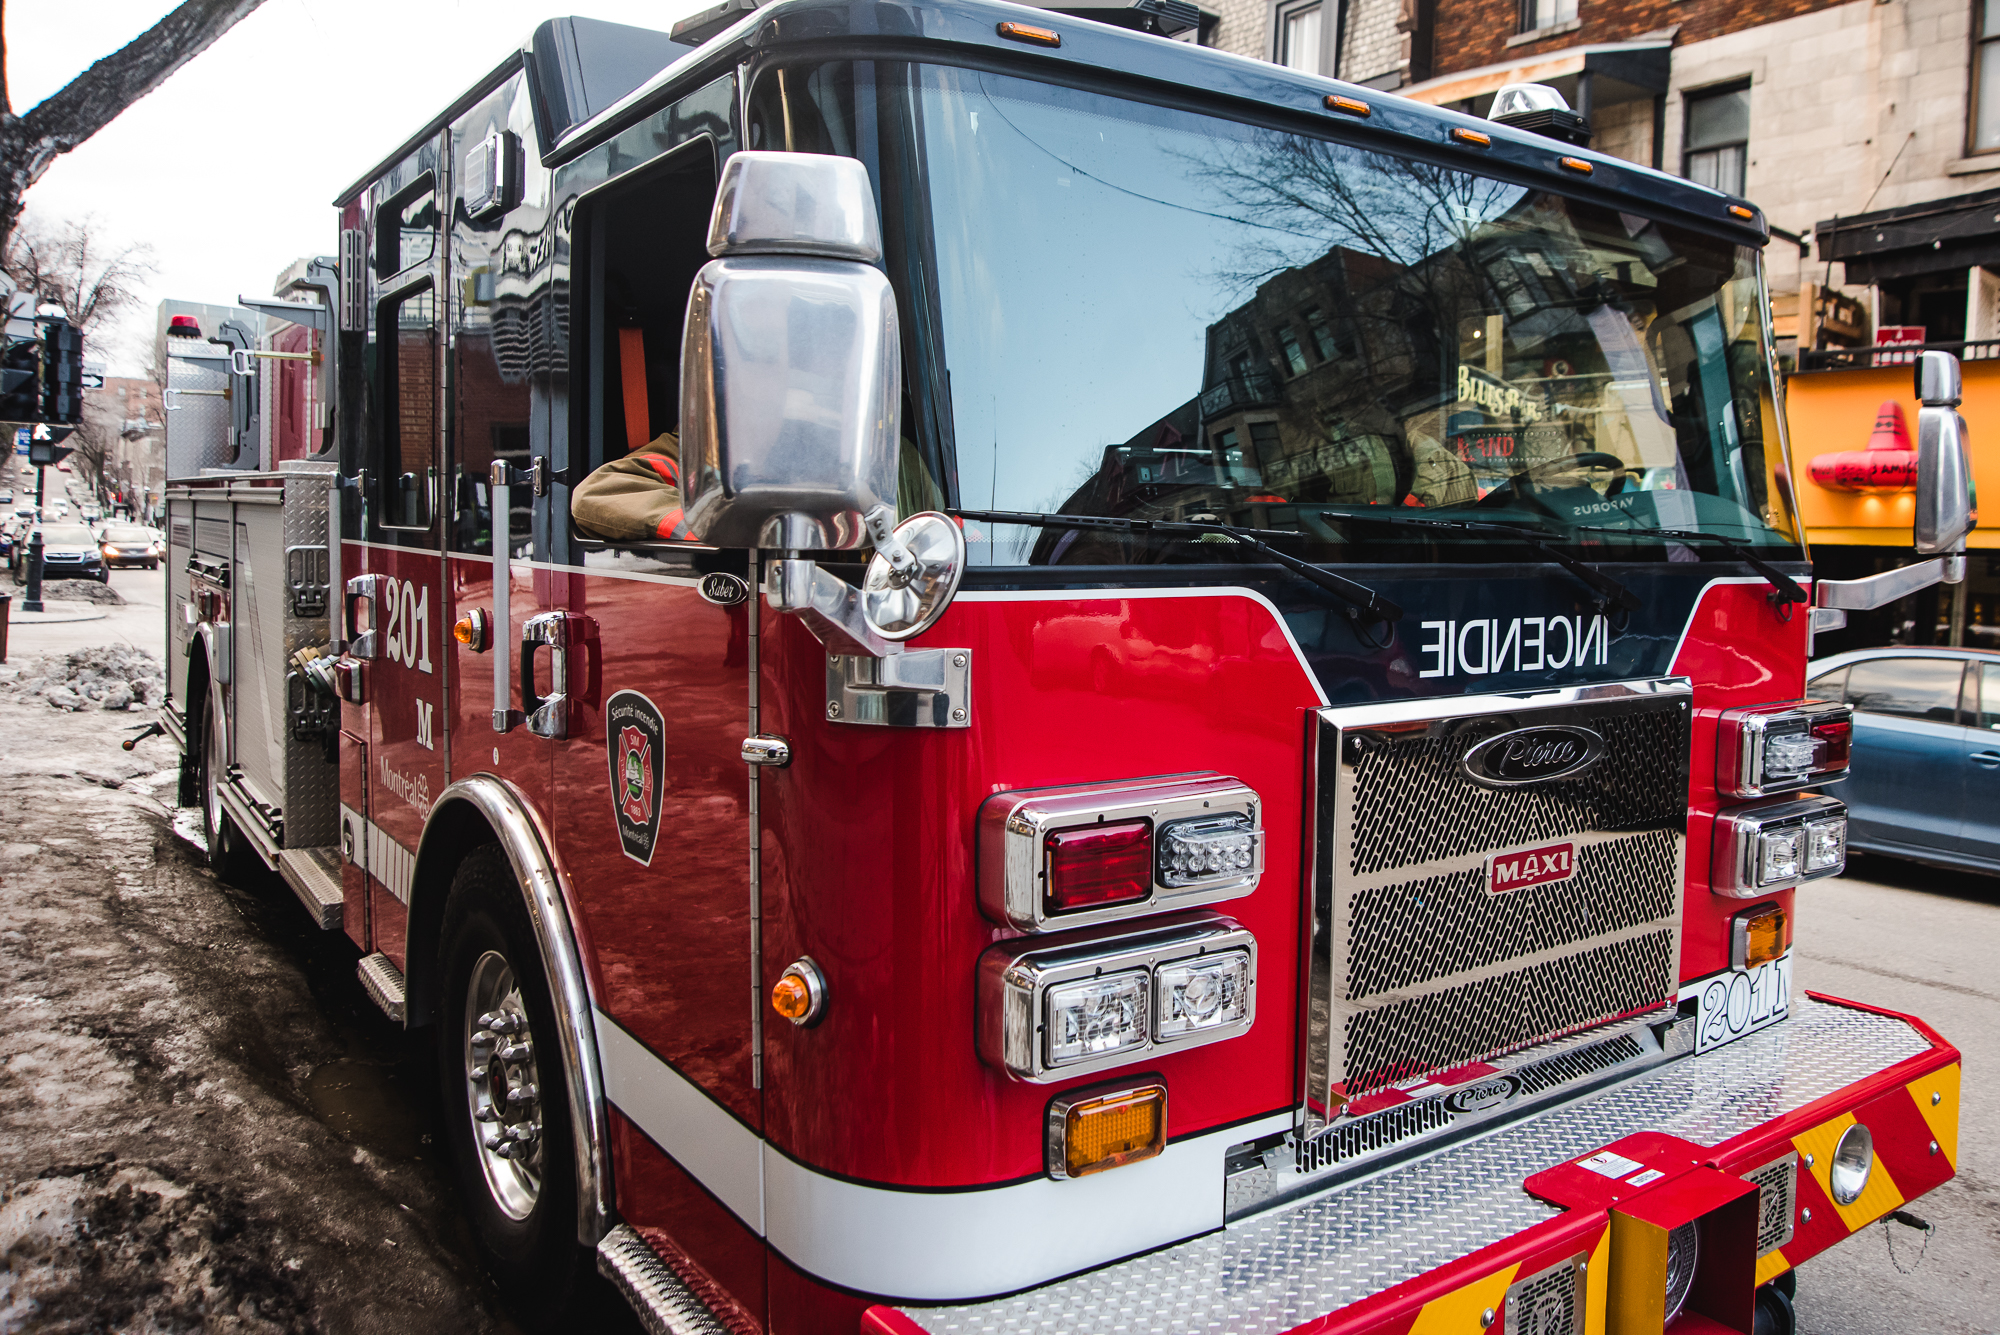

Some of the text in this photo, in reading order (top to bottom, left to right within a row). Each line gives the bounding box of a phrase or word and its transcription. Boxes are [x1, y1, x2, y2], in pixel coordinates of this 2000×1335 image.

[708, 577, 735, 599] Saber
[385, 576, 433, 675] 201
[415, 697, 434, 751] M
[1499, 736, 1576, 776] Pierce
[380, 755, 418, 808] Montréal
[1495, 851, 1570, 884] MAXI
[1459, 1082, 1509, 1108] Pierce
